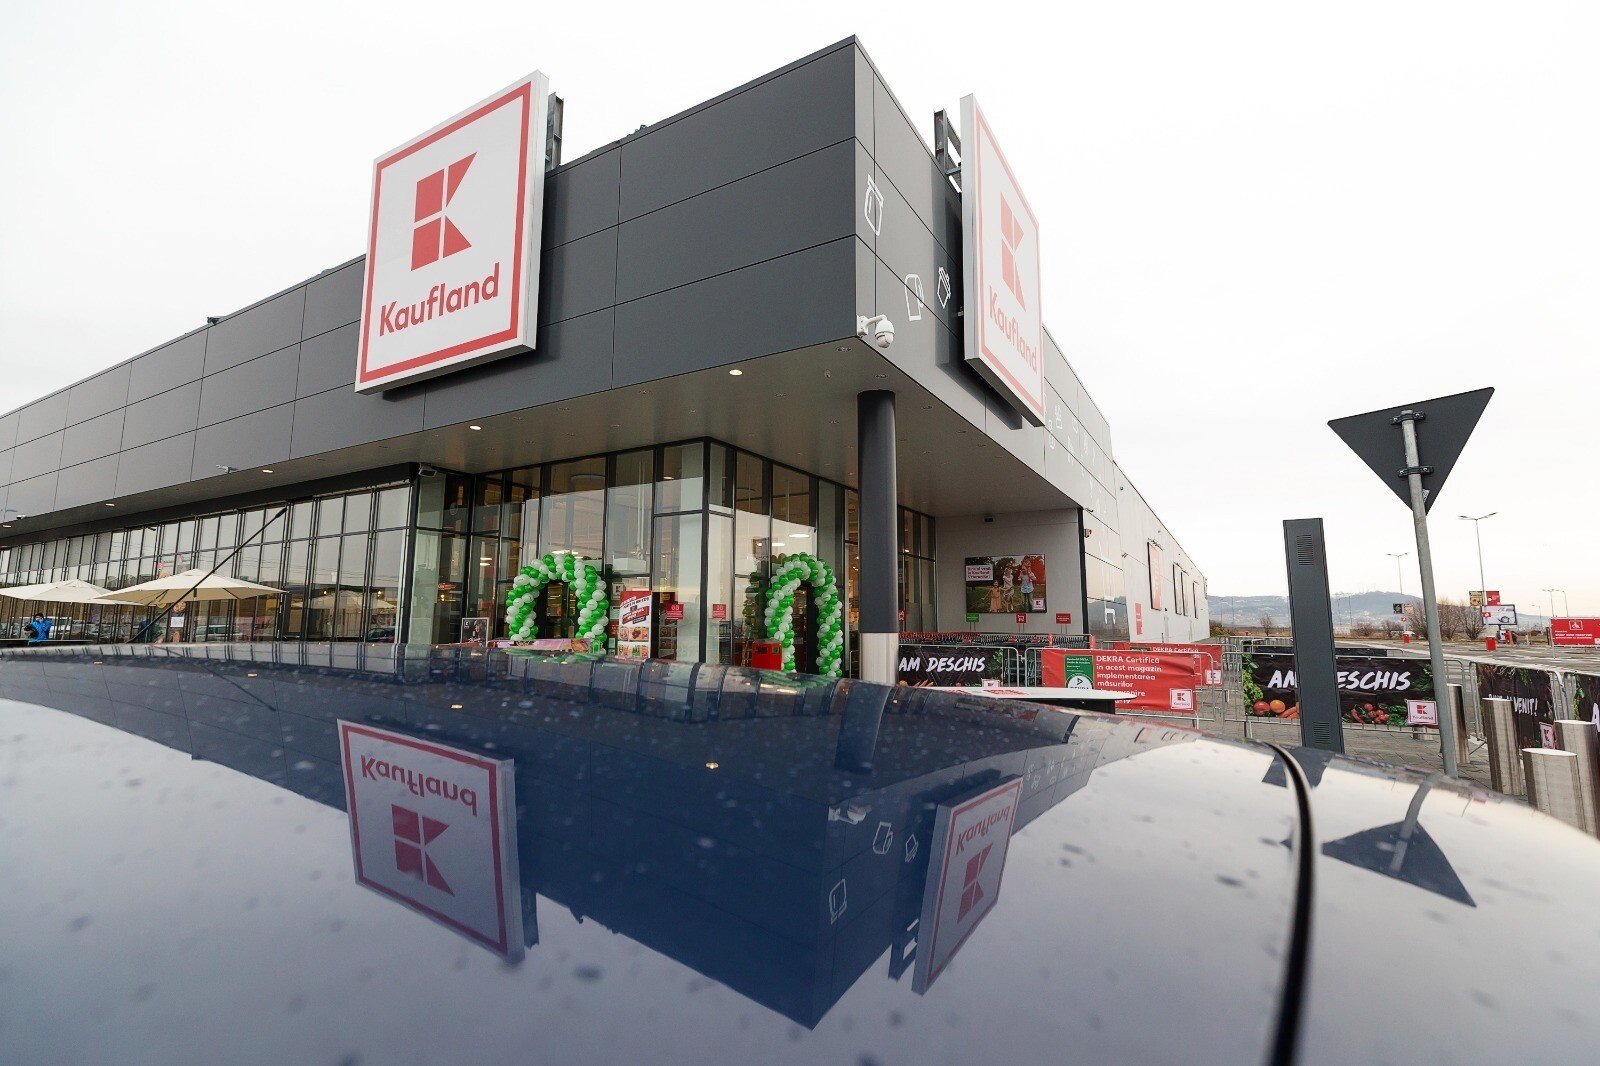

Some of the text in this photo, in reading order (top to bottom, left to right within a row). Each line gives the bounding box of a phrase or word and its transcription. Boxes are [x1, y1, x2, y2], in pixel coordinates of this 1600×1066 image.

[411, 151, 477, 271] K
[379, 261, 499, 337] Kaufland
[989, 285, 1038, 374] Kaufland
[898, 656, 986, 673] AM DESCHIS
[1127, 665, 1162, 673] magazin
[1096, 672, 1156, 680] implementarea
[1336, 670, 1411, 691] ESCHIS
[1513, 697, 1538, 717] VENIT!
